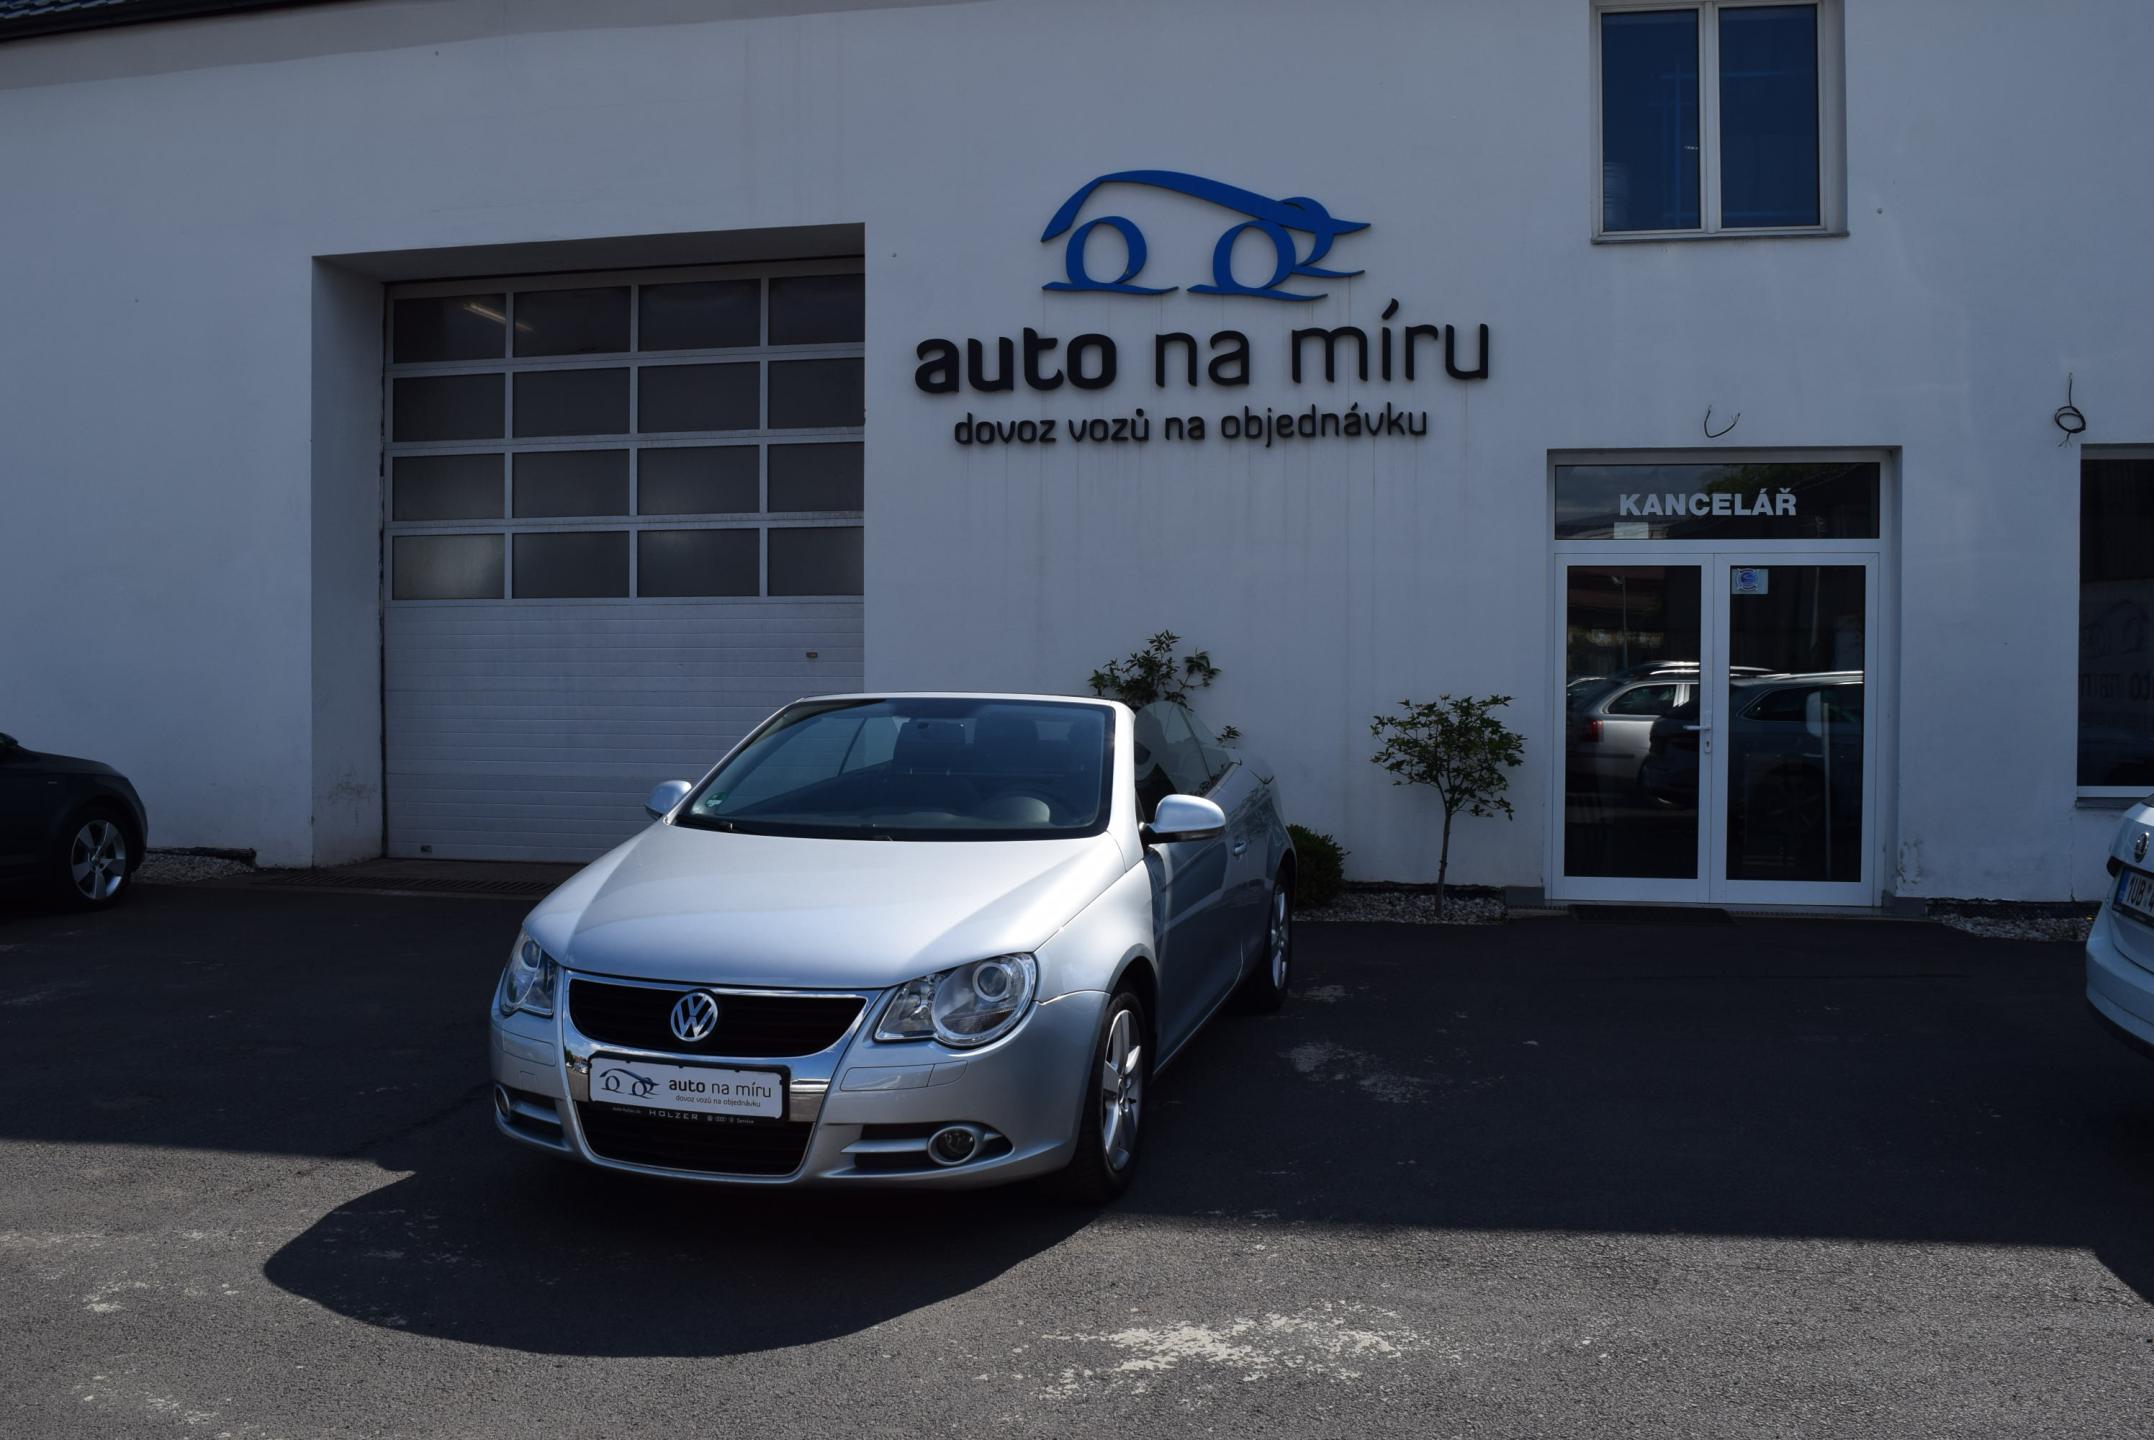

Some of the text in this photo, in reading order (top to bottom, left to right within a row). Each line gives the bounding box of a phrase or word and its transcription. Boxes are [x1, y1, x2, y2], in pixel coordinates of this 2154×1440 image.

[915, 298, 1490, 397] auto na míru
[954, 402, 1428, 448] dovoz vozů na objednávku
[1619, 487, 1797, 516] KANCELÁŘ
[669, 1080, 772, 1098] auto na míru
[675, 1095, 695, 1103] dovoz
[648, 1108, 699, 1120] HOLZER
